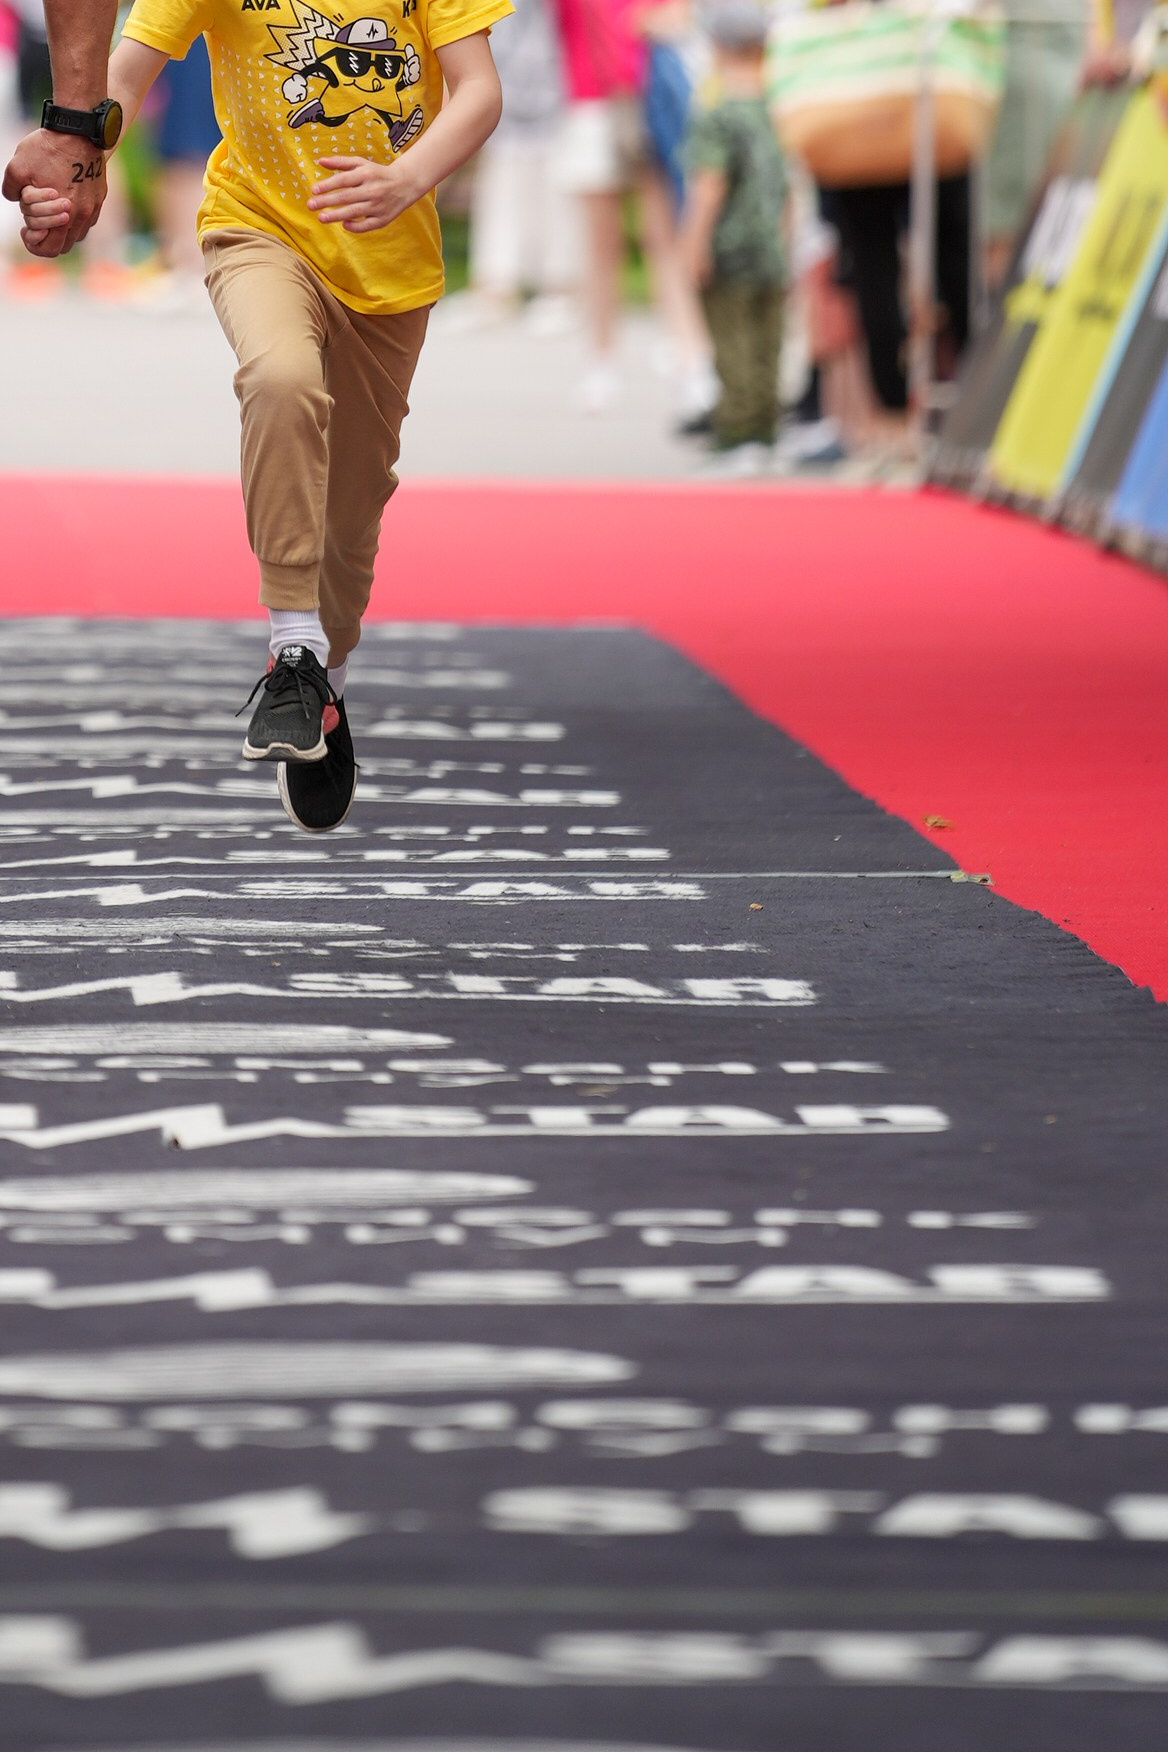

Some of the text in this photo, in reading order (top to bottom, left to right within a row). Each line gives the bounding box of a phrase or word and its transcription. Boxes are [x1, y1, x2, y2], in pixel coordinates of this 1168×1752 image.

[237, 881, 705, 896] STAR
[287, 972, 816, 1000] STAR
[343, 1104, 951, 1128] STAR
[405, 1263, 1110, 1298] STAR
